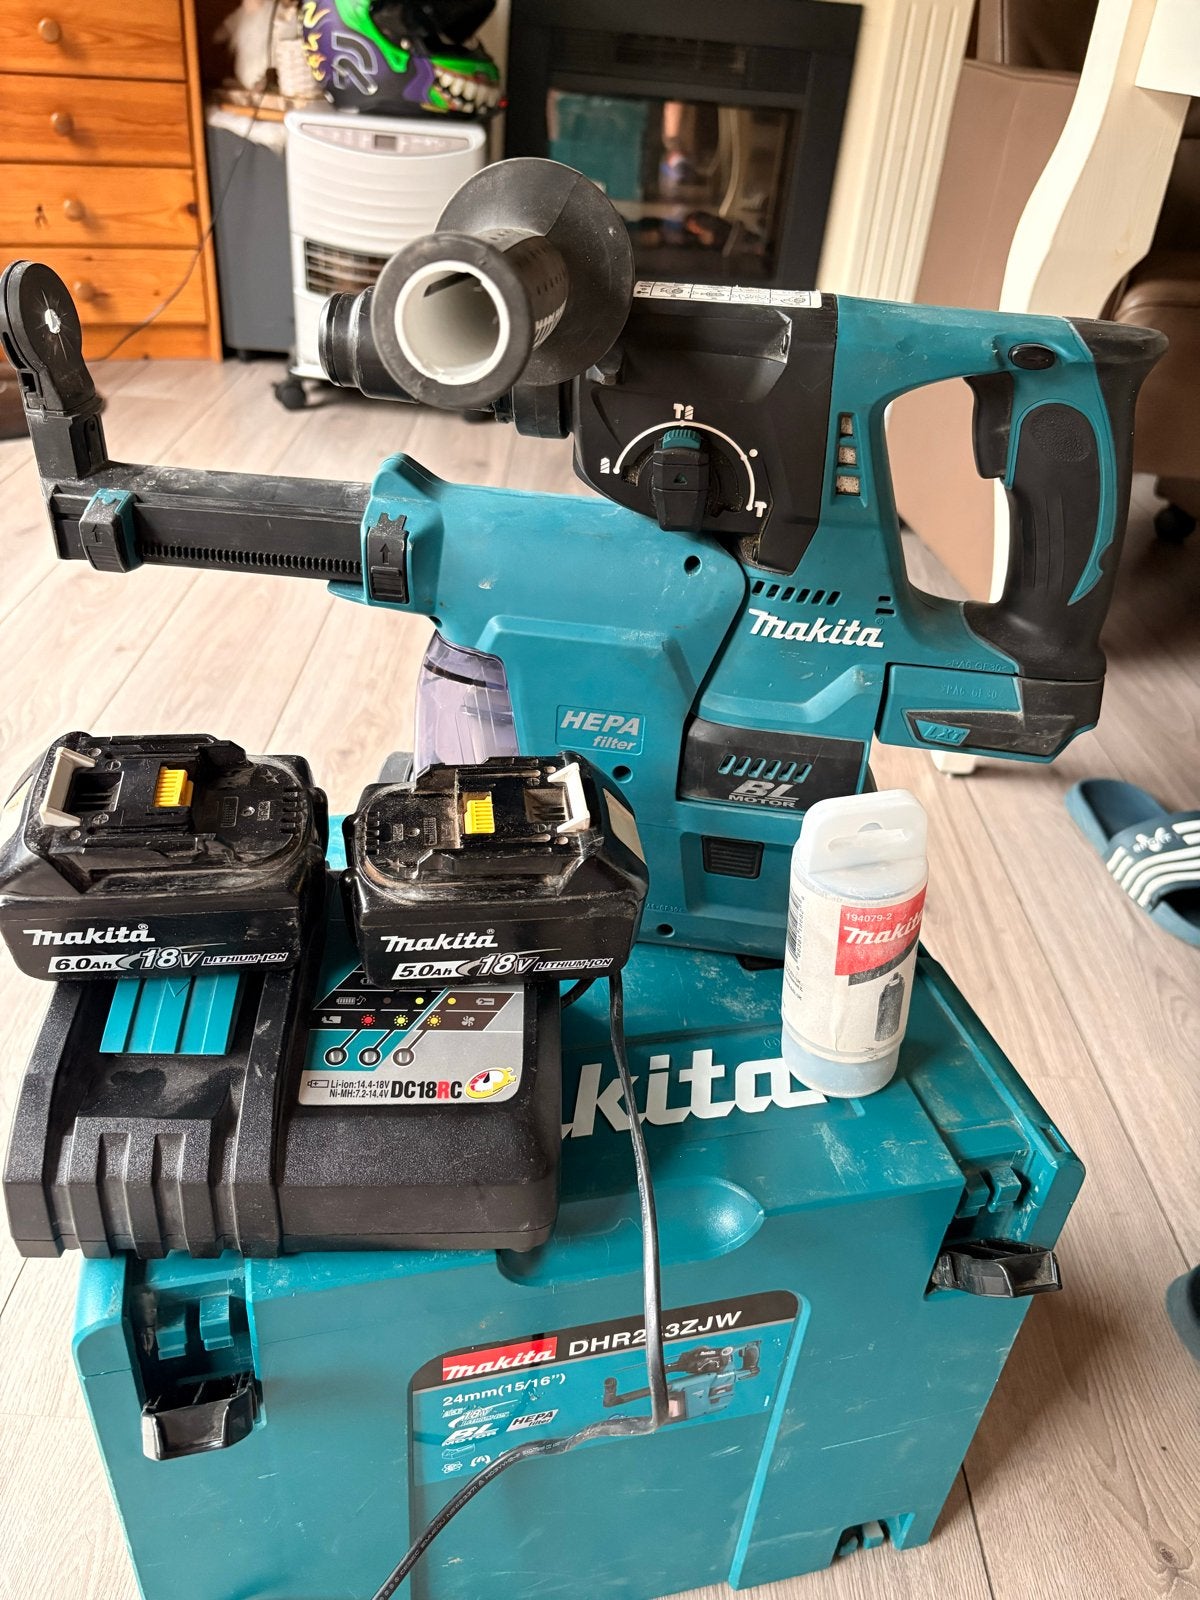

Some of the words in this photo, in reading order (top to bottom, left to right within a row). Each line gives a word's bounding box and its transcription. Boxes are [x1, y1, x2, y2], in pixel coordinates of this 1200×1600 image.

[748, 607, 884, 648] Makita
[560, 710, 641, 737] HEPA
[593, 735, 637, 750] filter
[728, 794, 797, 808] MOTOR
[731, 779, 800, 801] BL
[846, 912, 892, 922] 194079-2
[23, 926, 155, 946] Makita
[380, 931, 498, 953] Makita
[55, 957, 112, 971] 6.0Ah
[139, 948, 204, 970] 18V
[202, 953, 289, 966] LITHIUM-ION
[399, 963, 452, 978] 5.0Ah
[476, 953, 539, 976] 18V
[534, 957, 614, 972] LITHIUM-ION
[329, 1089, 389, 1098] Ni-MH:7.2-14.4V
[330, 1080, 389, 1089] Li-ion:14.4-18V
[390, 1080, 463, 1100] DC18RC
[562, 1048, 828, 1140] kita
[568, 1310, 743, 1357] DHR23ZJW
[443, 1347, 556, 1380] Makita
[512, 1411, 554, 1426] HEPA
